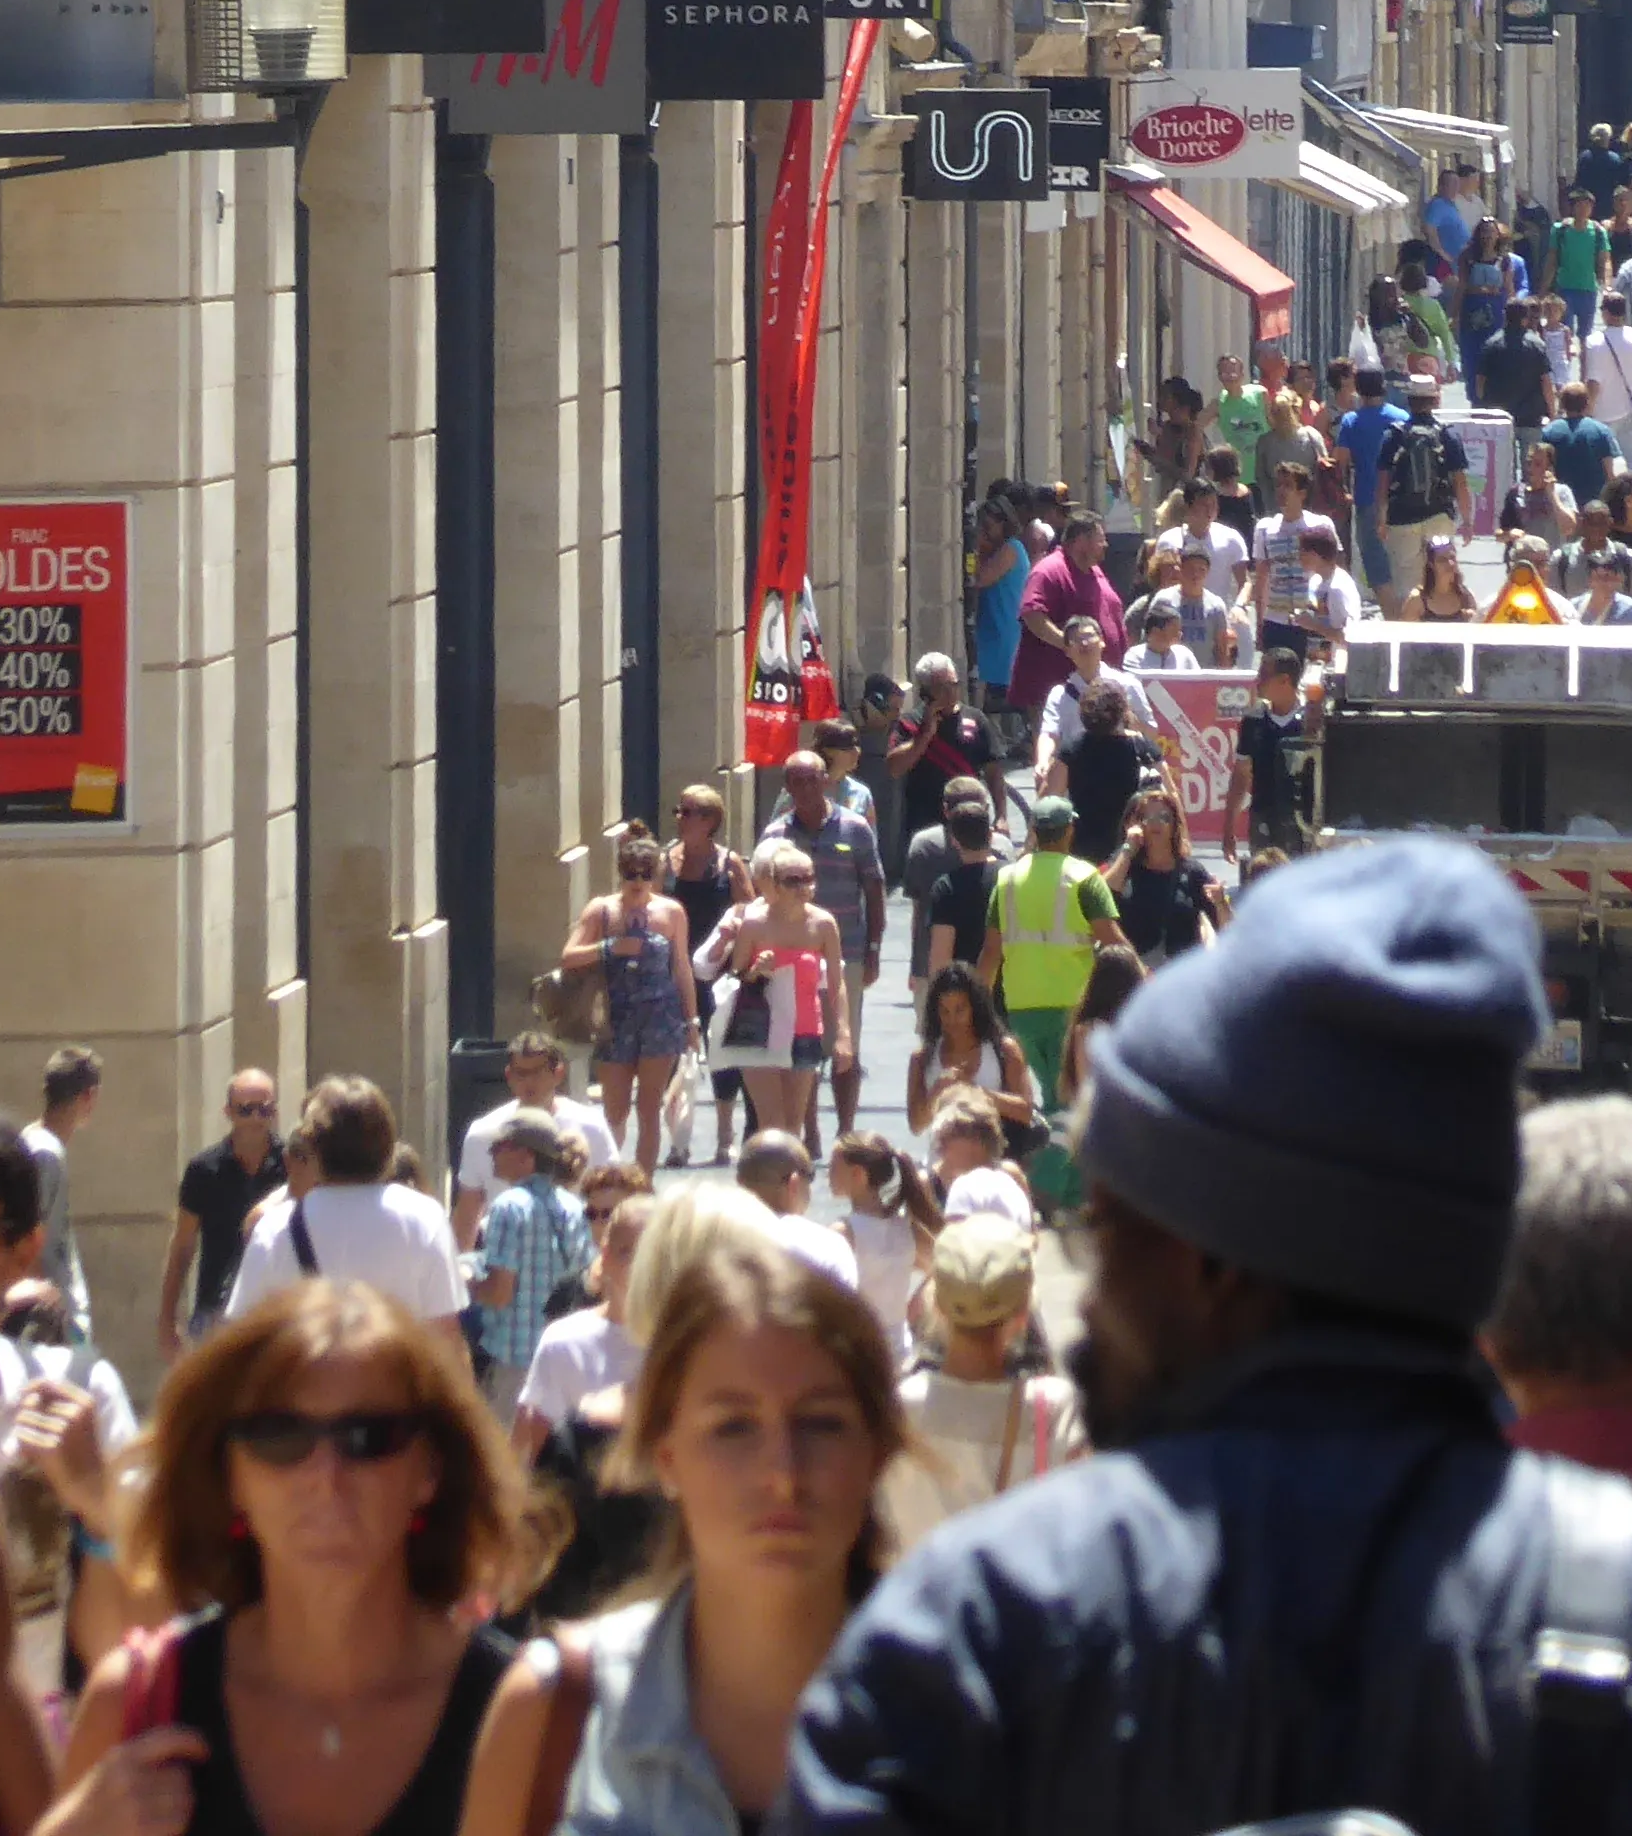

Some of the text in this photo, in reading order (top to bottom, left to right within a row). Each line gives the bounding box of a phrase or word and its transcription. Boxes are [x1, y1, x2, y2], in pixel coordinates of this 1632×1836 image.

[664, 4, 811, 25] SEPHORA
[1147, 111, 1234, 141] Brioche
[11, 527, 49, 544] FNAC
